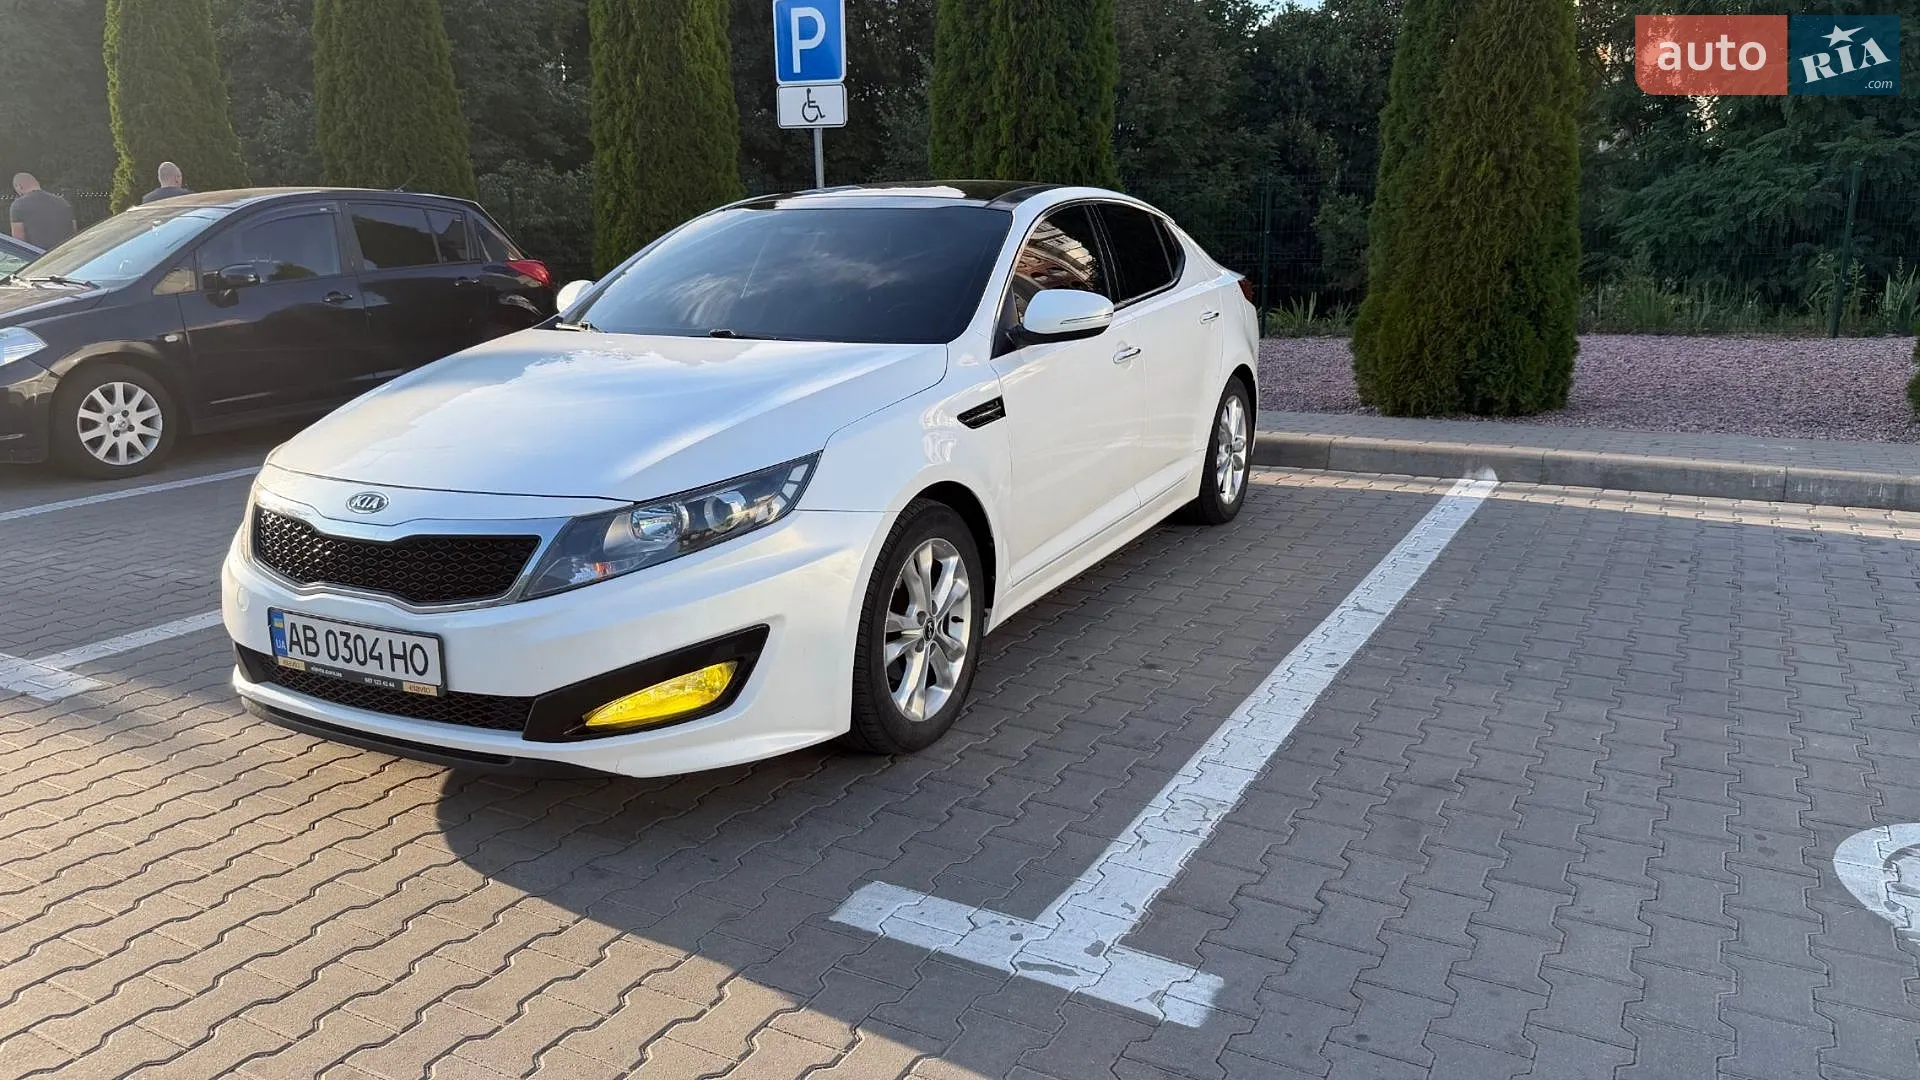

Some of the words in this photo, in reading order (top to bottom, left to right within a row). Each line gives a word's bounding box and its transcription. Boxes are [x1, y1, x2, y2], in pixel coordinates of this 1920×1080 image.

[790, 6, 826, 73] P
[275, 637, 286, 650] UA
[288, 622, 320, 658] AB
[325, 629, 384, 671] 0304
[388, 639, 429, 676] HO
